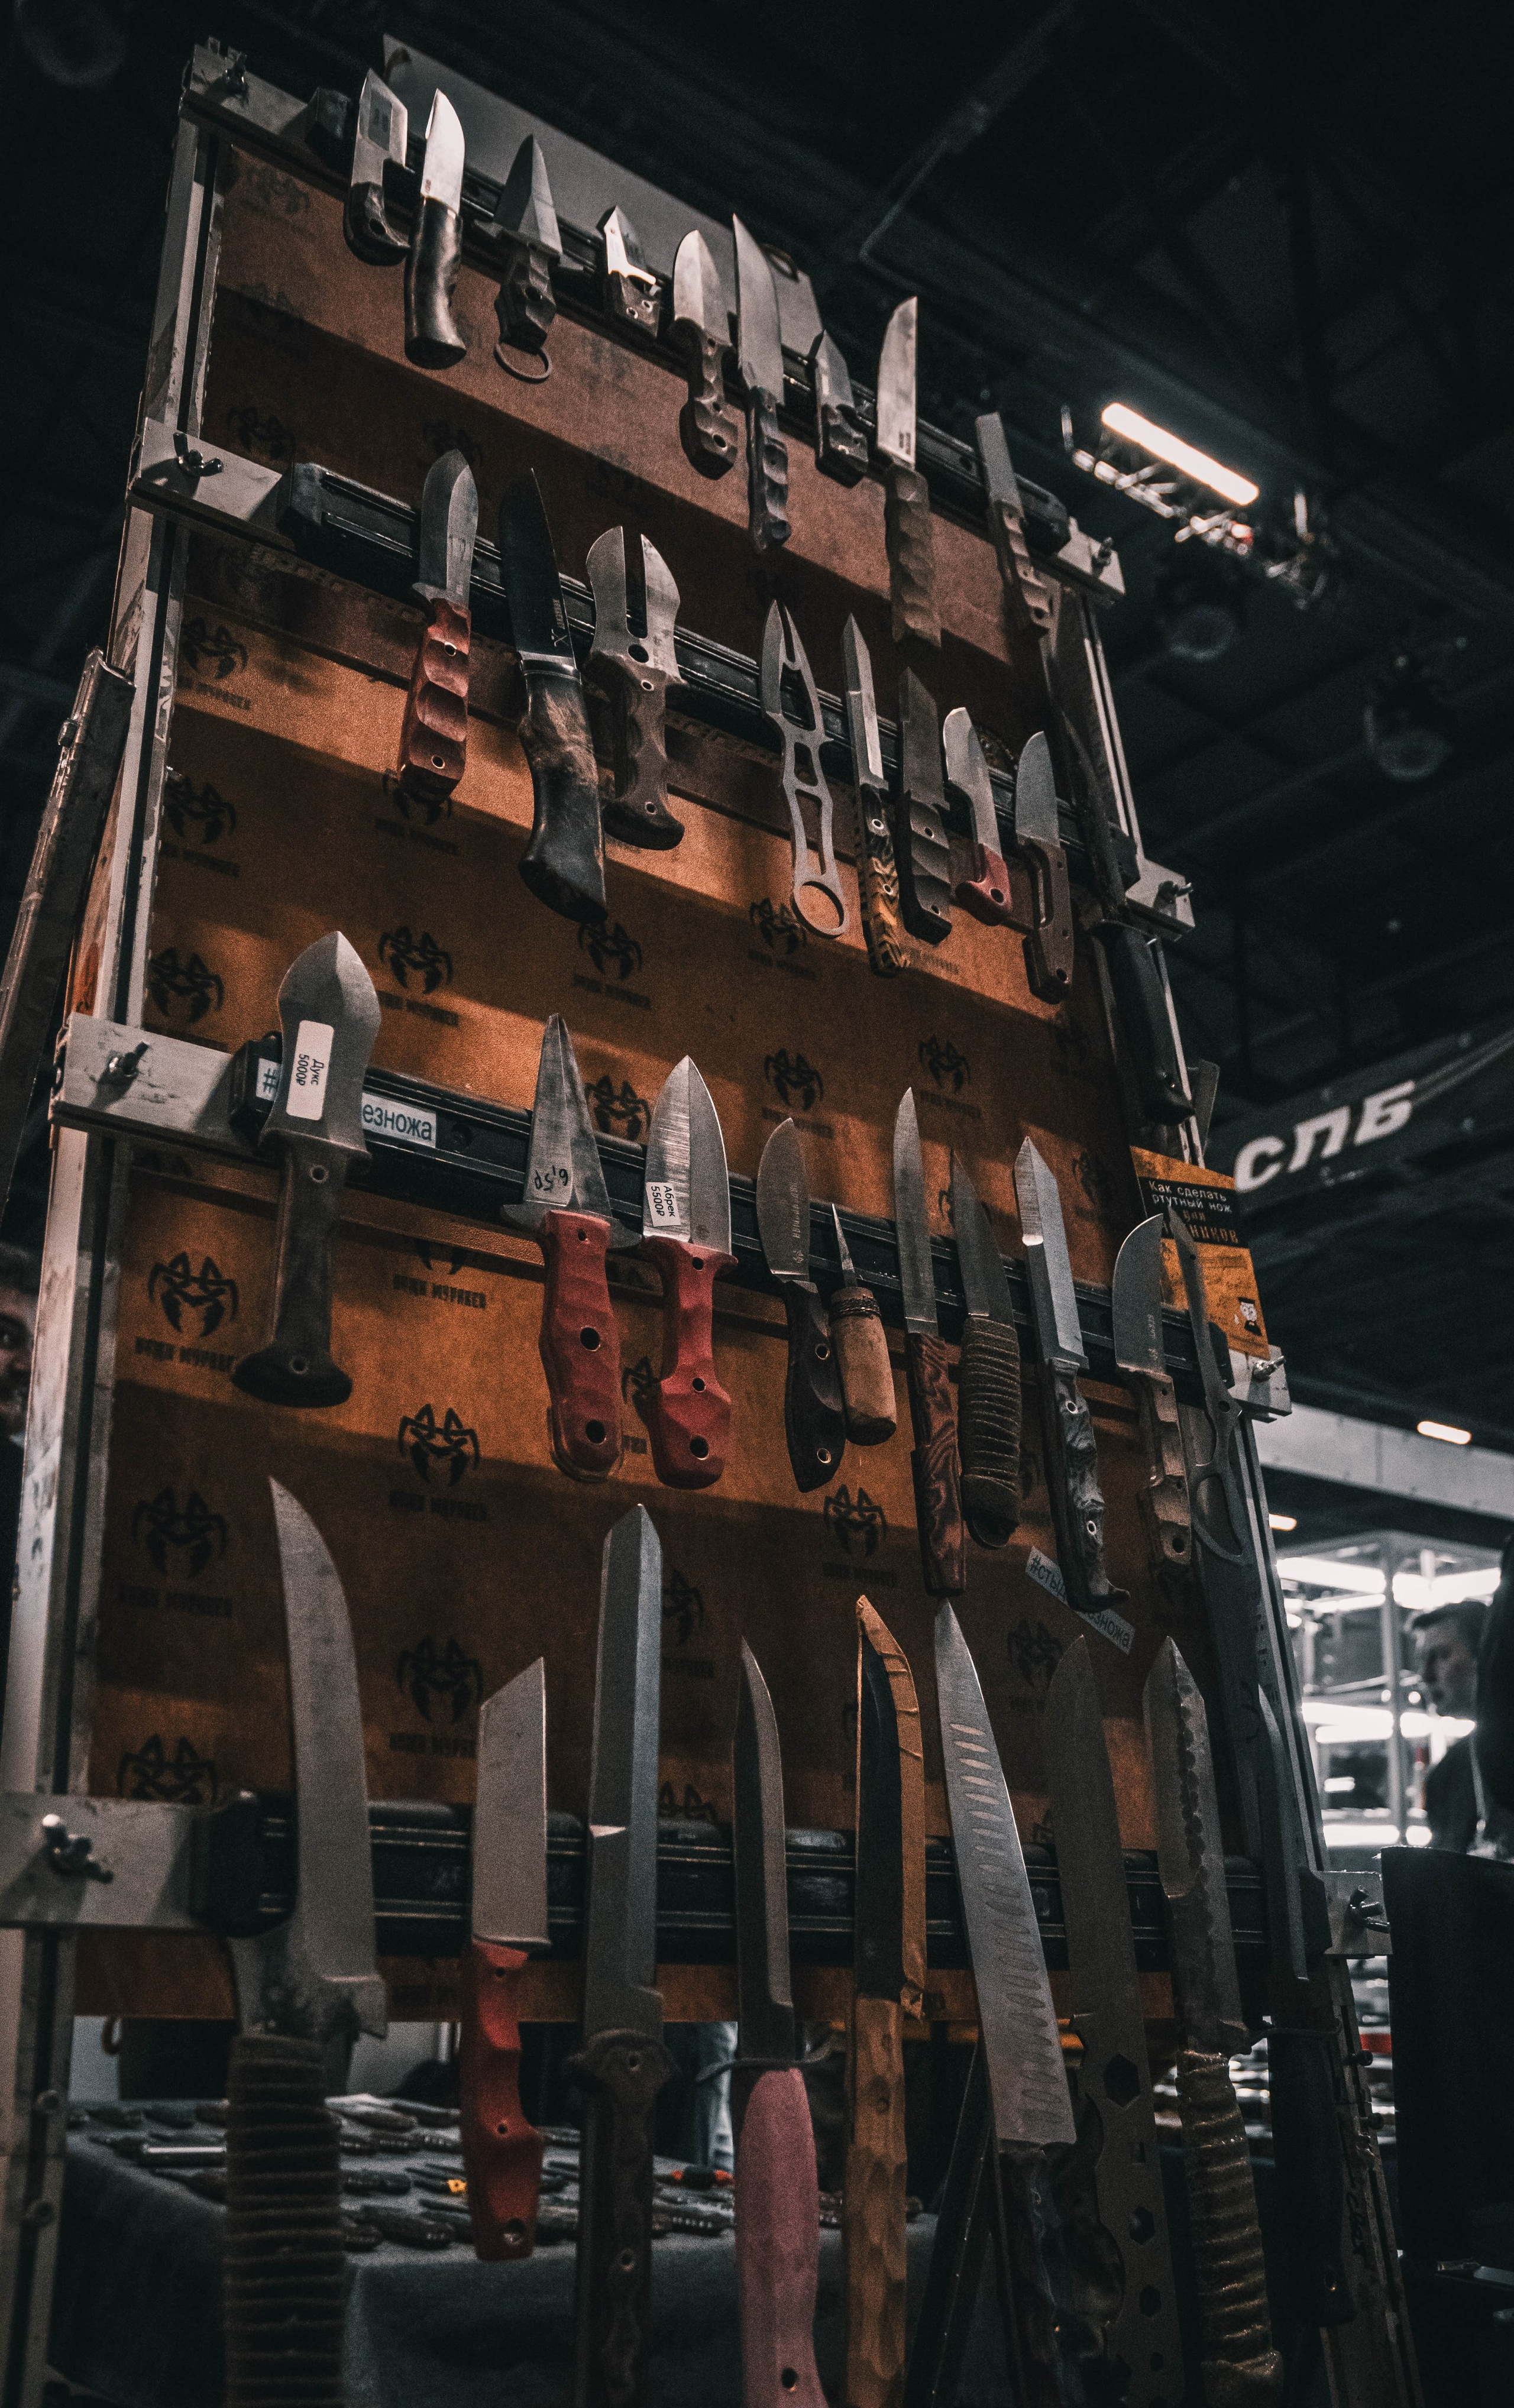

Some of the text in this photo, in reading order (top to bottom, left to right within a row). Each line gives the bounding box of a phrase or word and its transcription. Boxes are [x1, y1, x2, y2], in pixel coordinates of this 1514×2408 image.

[310, 1059, 325, 1086] Дукс
[361, 1103, 433, 1141] езножа
[663, 1184, 676, 1218] Абрек
[1149, 1180, 1227, 1202] Как сделать
[1151, 1193, 1232, 1213] ртутный нож
